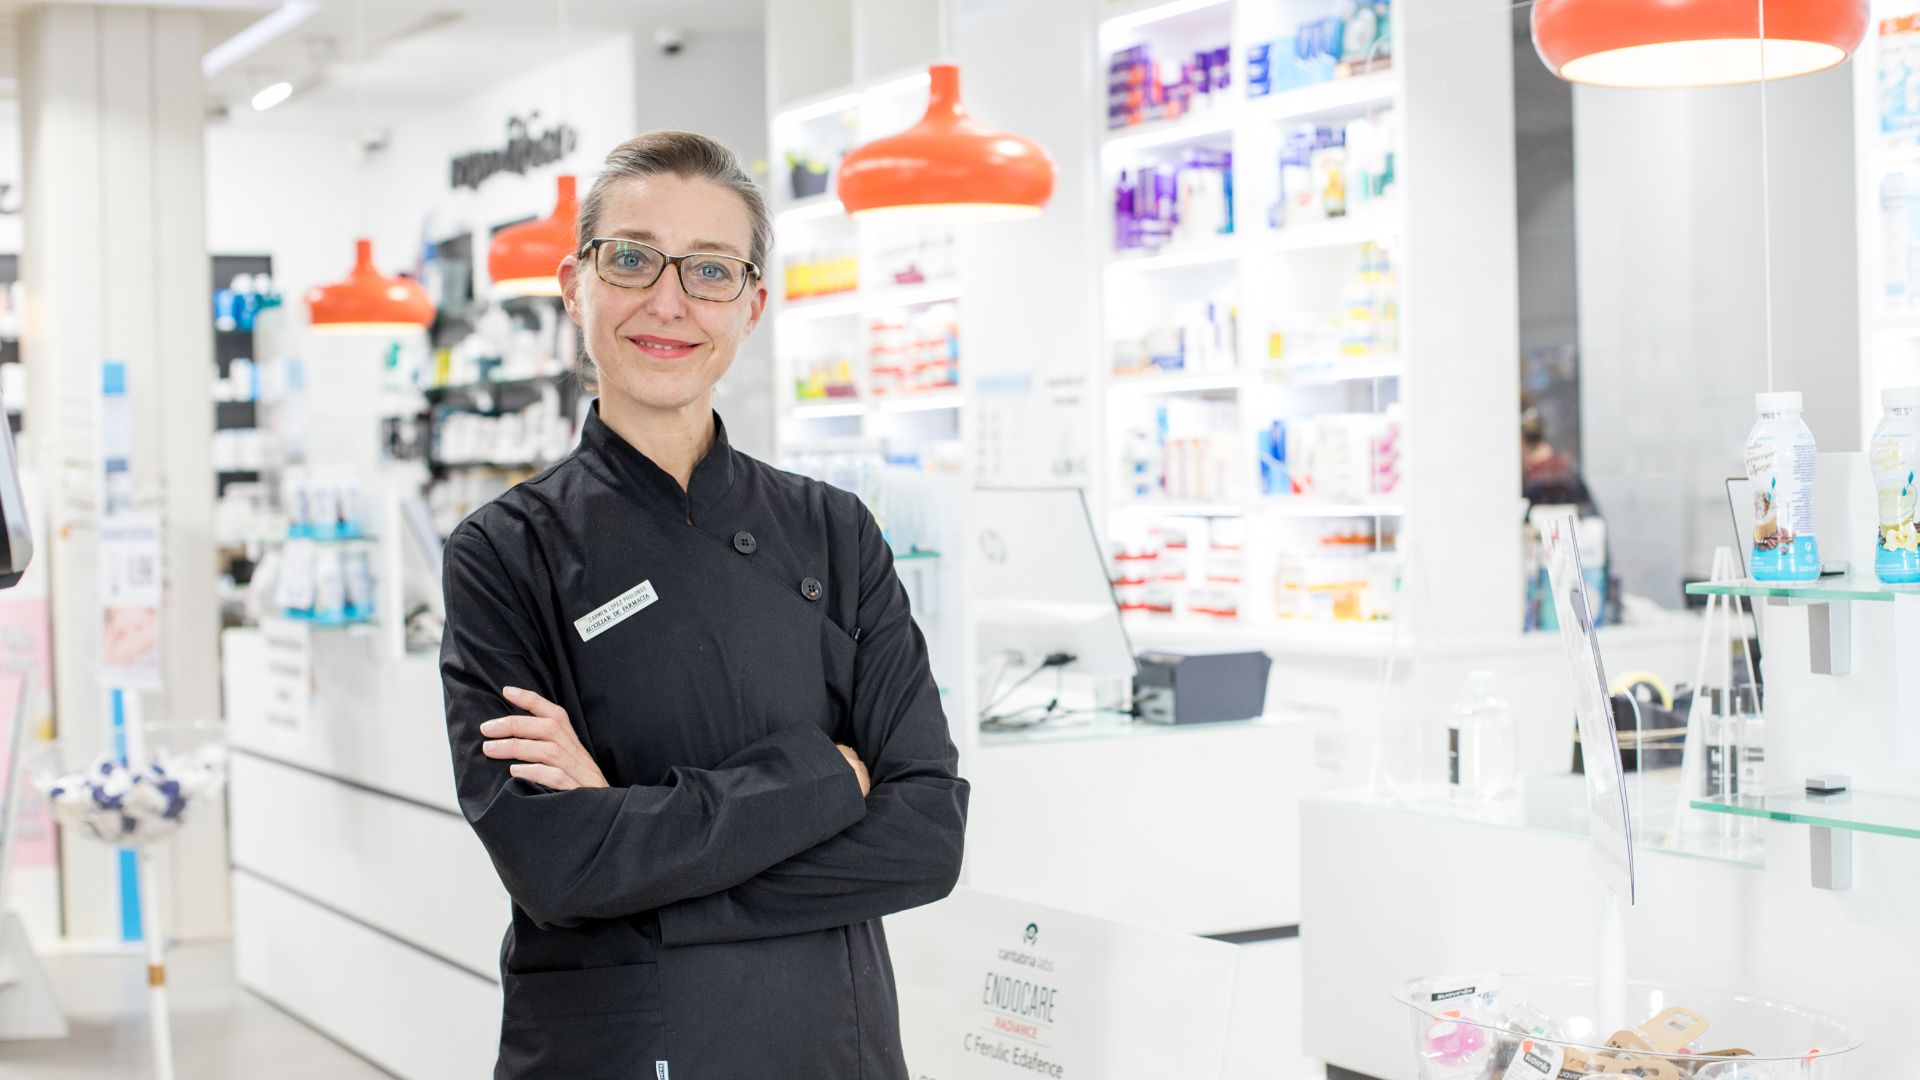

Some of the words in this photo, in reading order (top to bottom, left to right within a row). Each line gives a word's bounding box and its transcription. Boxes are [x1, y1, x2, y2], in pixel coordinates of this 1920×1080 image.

[585, 615, 613, 633] AUXILIAR
[612, 609, 622, 618] DE
[622, 593, 650, 612] FARMACIA
[588, 608, 608, 623] CARMEN
[608, 599, 622, 612] LOPEZ
[998, 949, 1036, 968] cantabria
[1037, 957, 1055, 973] labs
[983, 971, 1058, 1023] ENDOCARE
[994, 1016, 1038, 1040] RADIANCE
[963, 1032, 974, 1052] C
[974, 1035, 1010, 1063] Ferulic
[1012, 1046, 1064, 1079] Edafence
